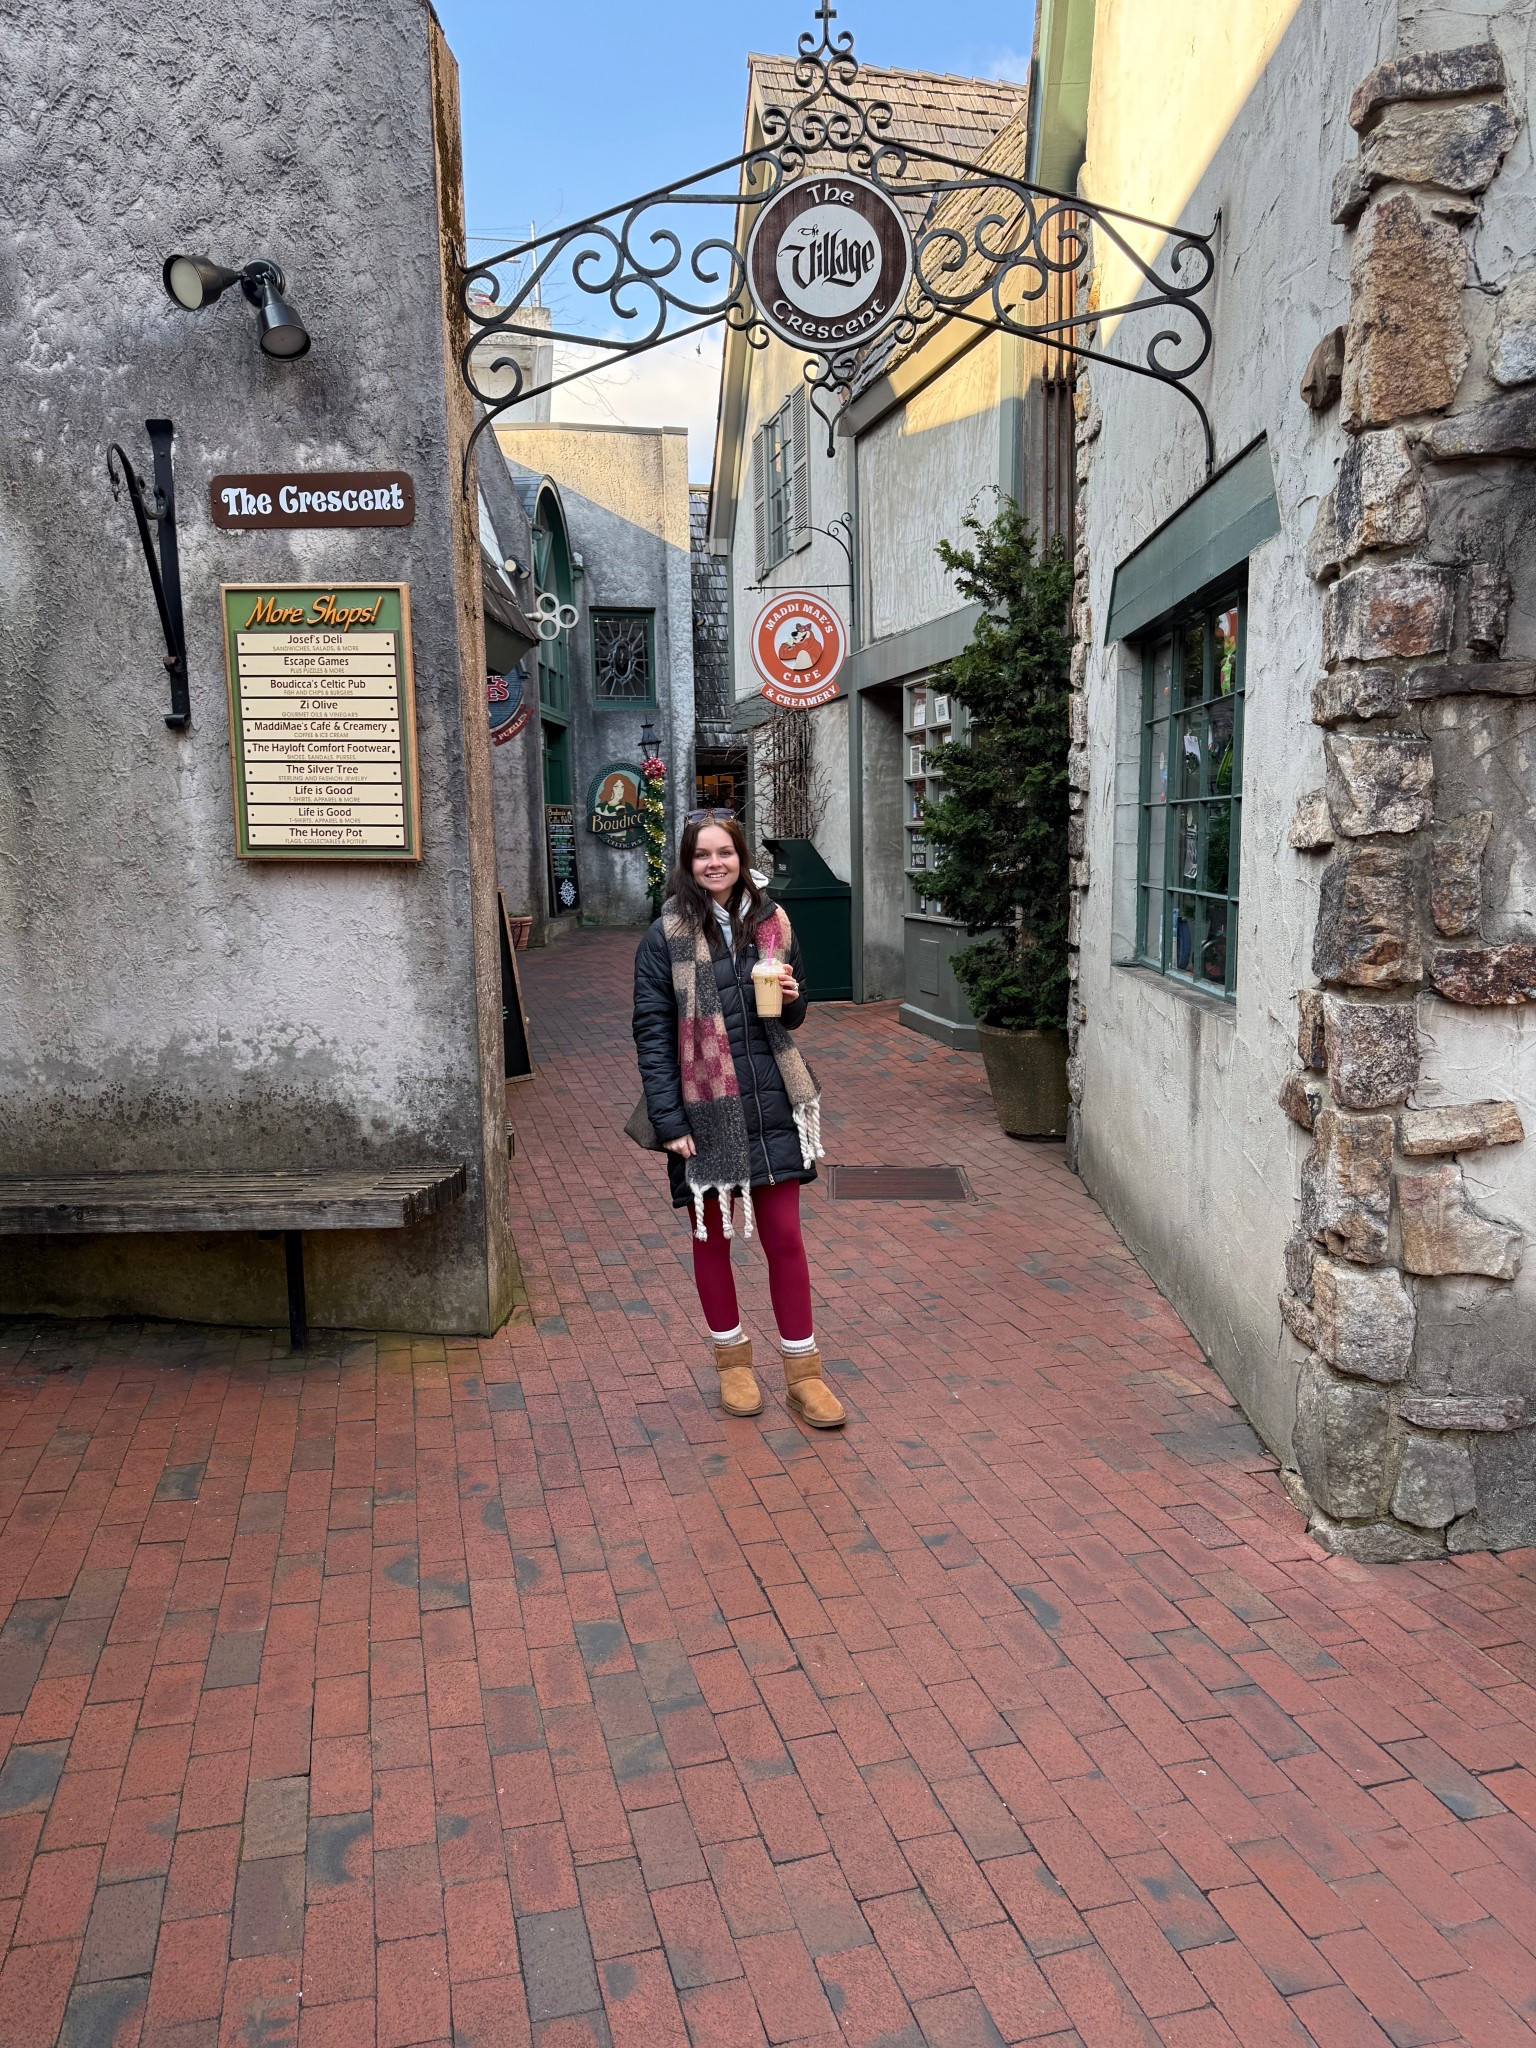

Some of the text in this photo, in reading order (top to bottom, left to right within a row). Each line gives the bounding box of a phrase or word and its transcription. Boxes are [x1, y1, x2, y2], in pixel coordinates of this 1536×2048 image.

[807, 183, 855, 205] The
[797, 224, 819, 238] The
[777, 228, 875, 290] Village
[772, 298, 886, 339] Crescent
[221, 483, 404, 516] The Crescent
[244, 594, 383, 633] More Shops!
[764, 603, 834, 634] MADDI MAE'S
[287, 635, 343, 644] Josef's Deli
[284, 657, 349, 668] Escape Games
[782, 669, 822, 683] CAFE
[270, 680, 366, 689] Boudicca's Celtic Pub
[765, 685, 837, 707] & CREAMERY
[300, 700, 338, 710] Zi Olive
[254, 722, 308, 731] MaddiMae's
[334, 722, 340, 731] &
[343, 722, 387, 733] Creamery
[497, 713, 528, 740] PUZZLES
[252, 743, 391, 754] The Hayloft Comfort Footwear
[286, 765, 359, 774] The Silver Tree
[295, 786, 353, 795] Life is Good
[298, 808, 352, 816] Life is Good
[592, 812, 644, 833] Boudicc
[289, 828, 362, 839] The Honey Pot
